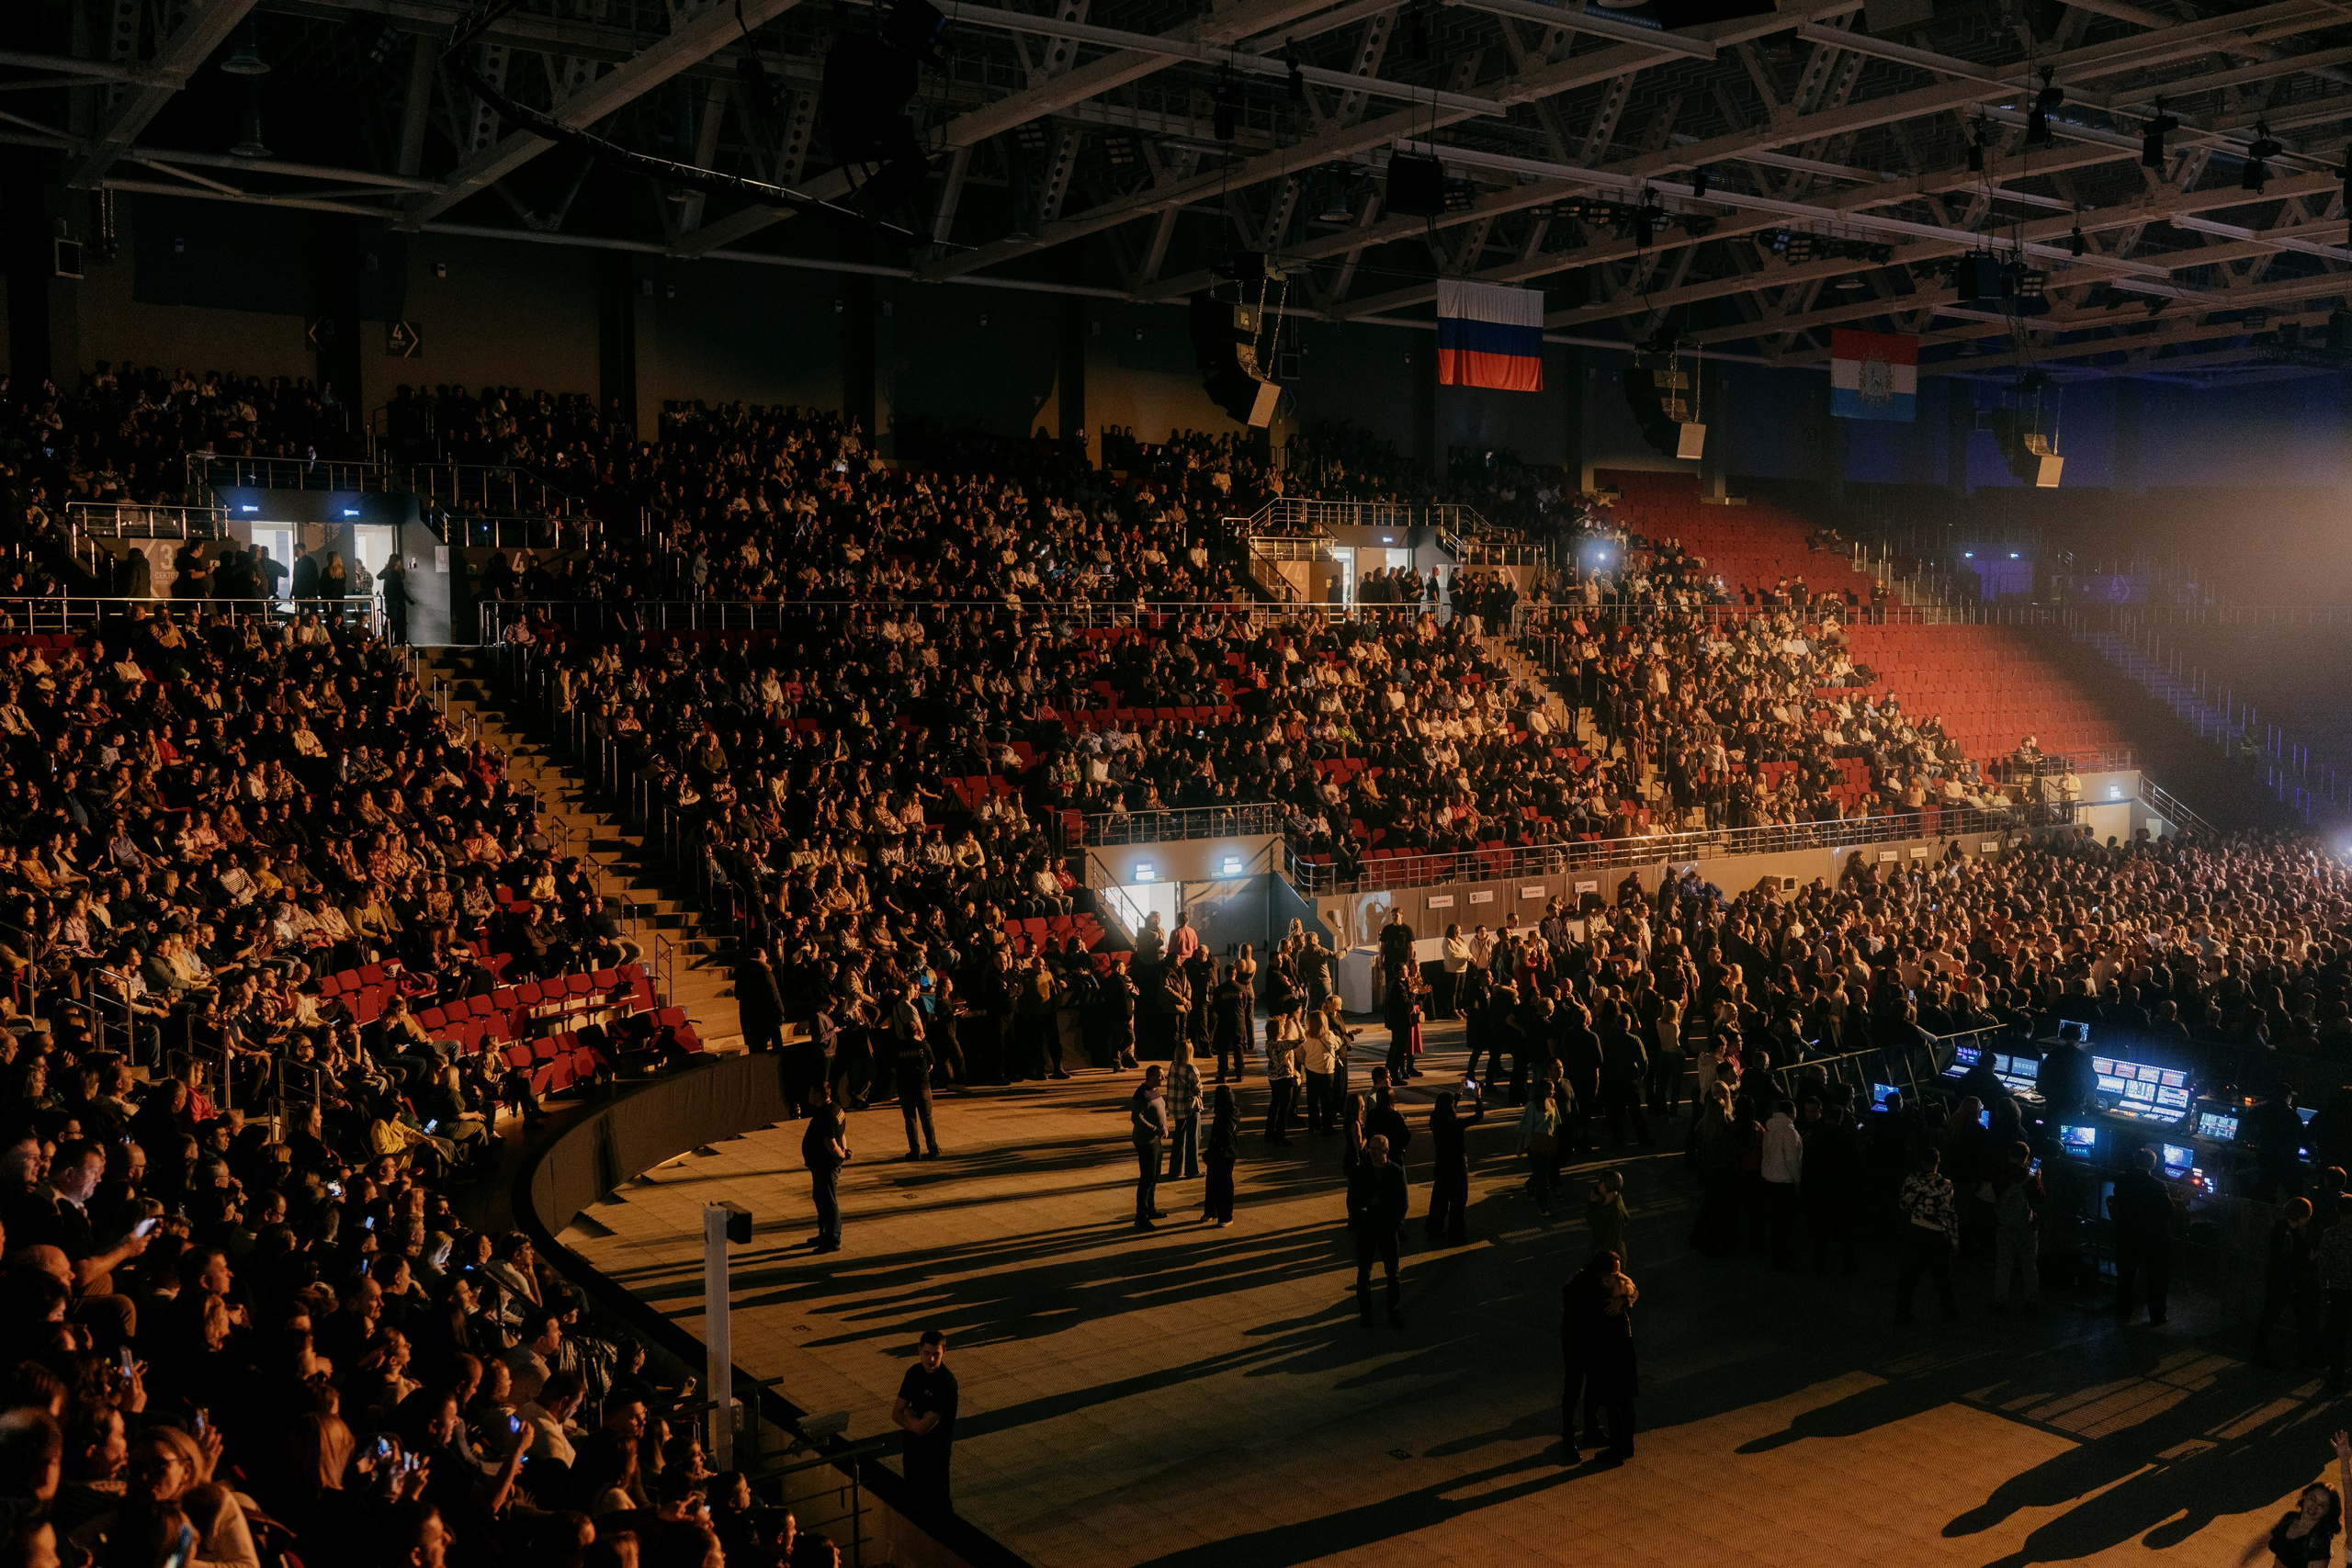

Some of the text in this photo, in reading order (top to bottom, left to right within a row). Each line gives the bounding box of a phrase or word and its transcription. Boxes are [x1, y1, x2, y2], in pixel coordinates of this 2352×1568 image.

[392, 323, 402, 340] 4
[160, 544, 174, 570] 3
[512, 552, 525, 574] 4
[1294, 564, 1304, 583] 4
[1498, 568, 1506, 585] 5
